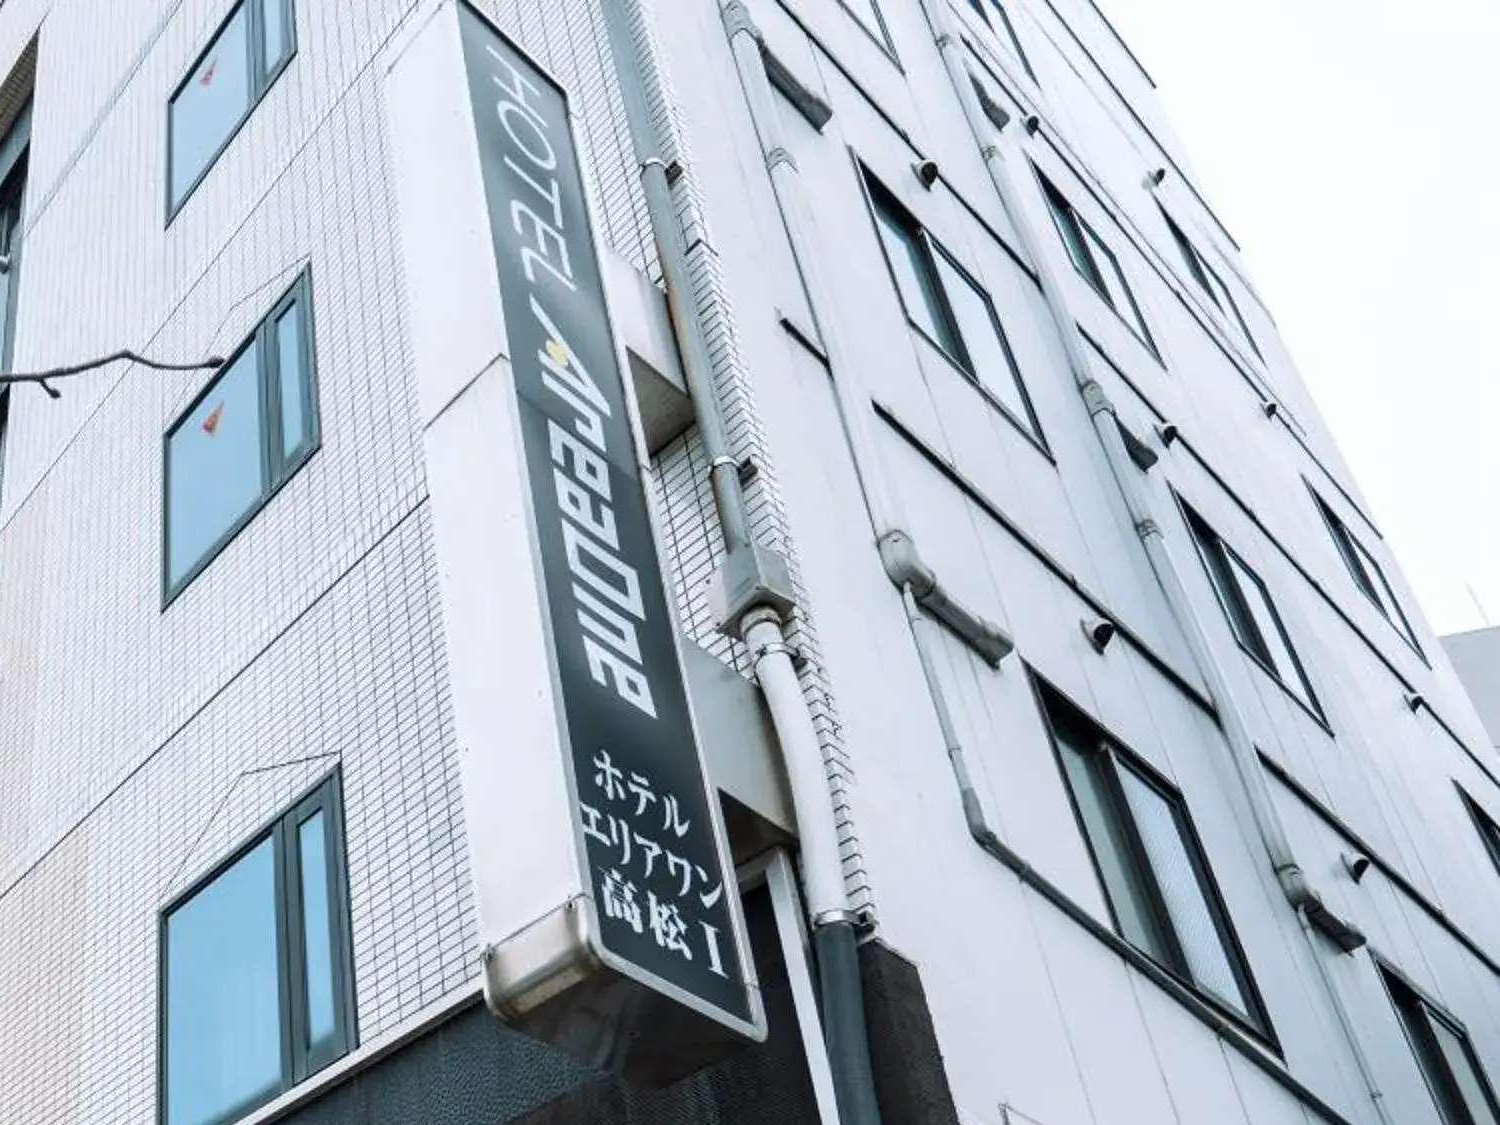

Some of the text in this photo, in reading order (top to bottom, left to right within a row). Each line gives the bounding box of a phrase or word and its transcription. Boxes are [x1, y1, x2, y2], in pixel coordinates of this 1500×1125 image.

[486, 43, 658, 720] HOTEL AreaOne
[593, 749, 691, 838] ホテル
[579, 800, 724, 909] エリアワン
